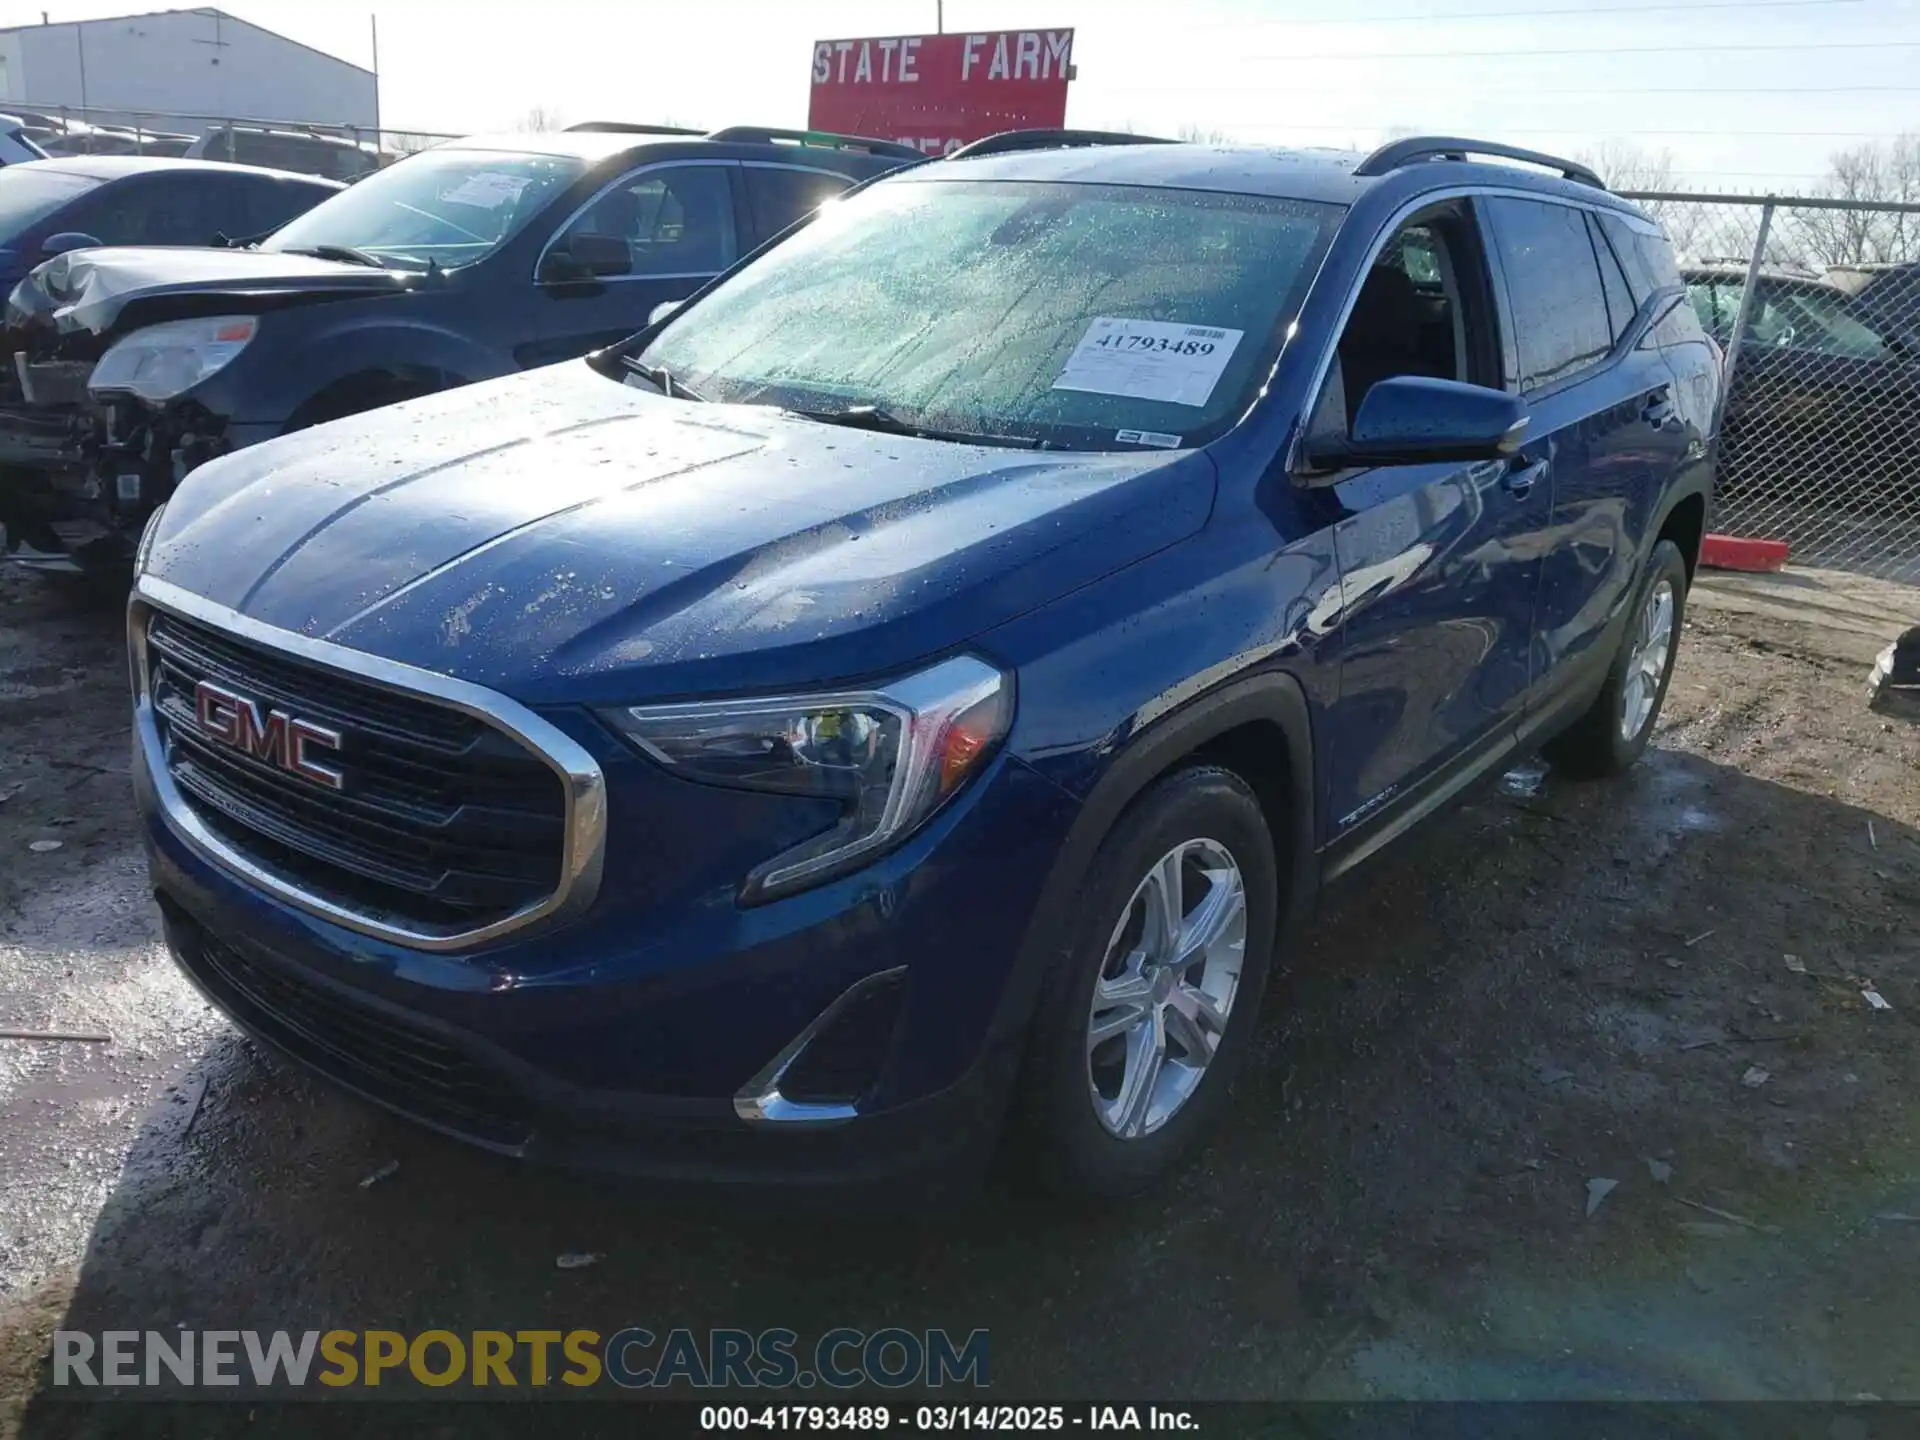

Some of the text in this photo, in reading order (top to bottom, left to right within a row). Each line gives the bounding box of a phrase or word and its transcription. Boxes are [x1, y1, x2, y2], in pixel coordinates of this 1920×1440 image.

[813, 31, 1072, 84] STATE FARM
[1096, 334, 1215, 357] 41793489
[195, 680, 343, 790] GMC
